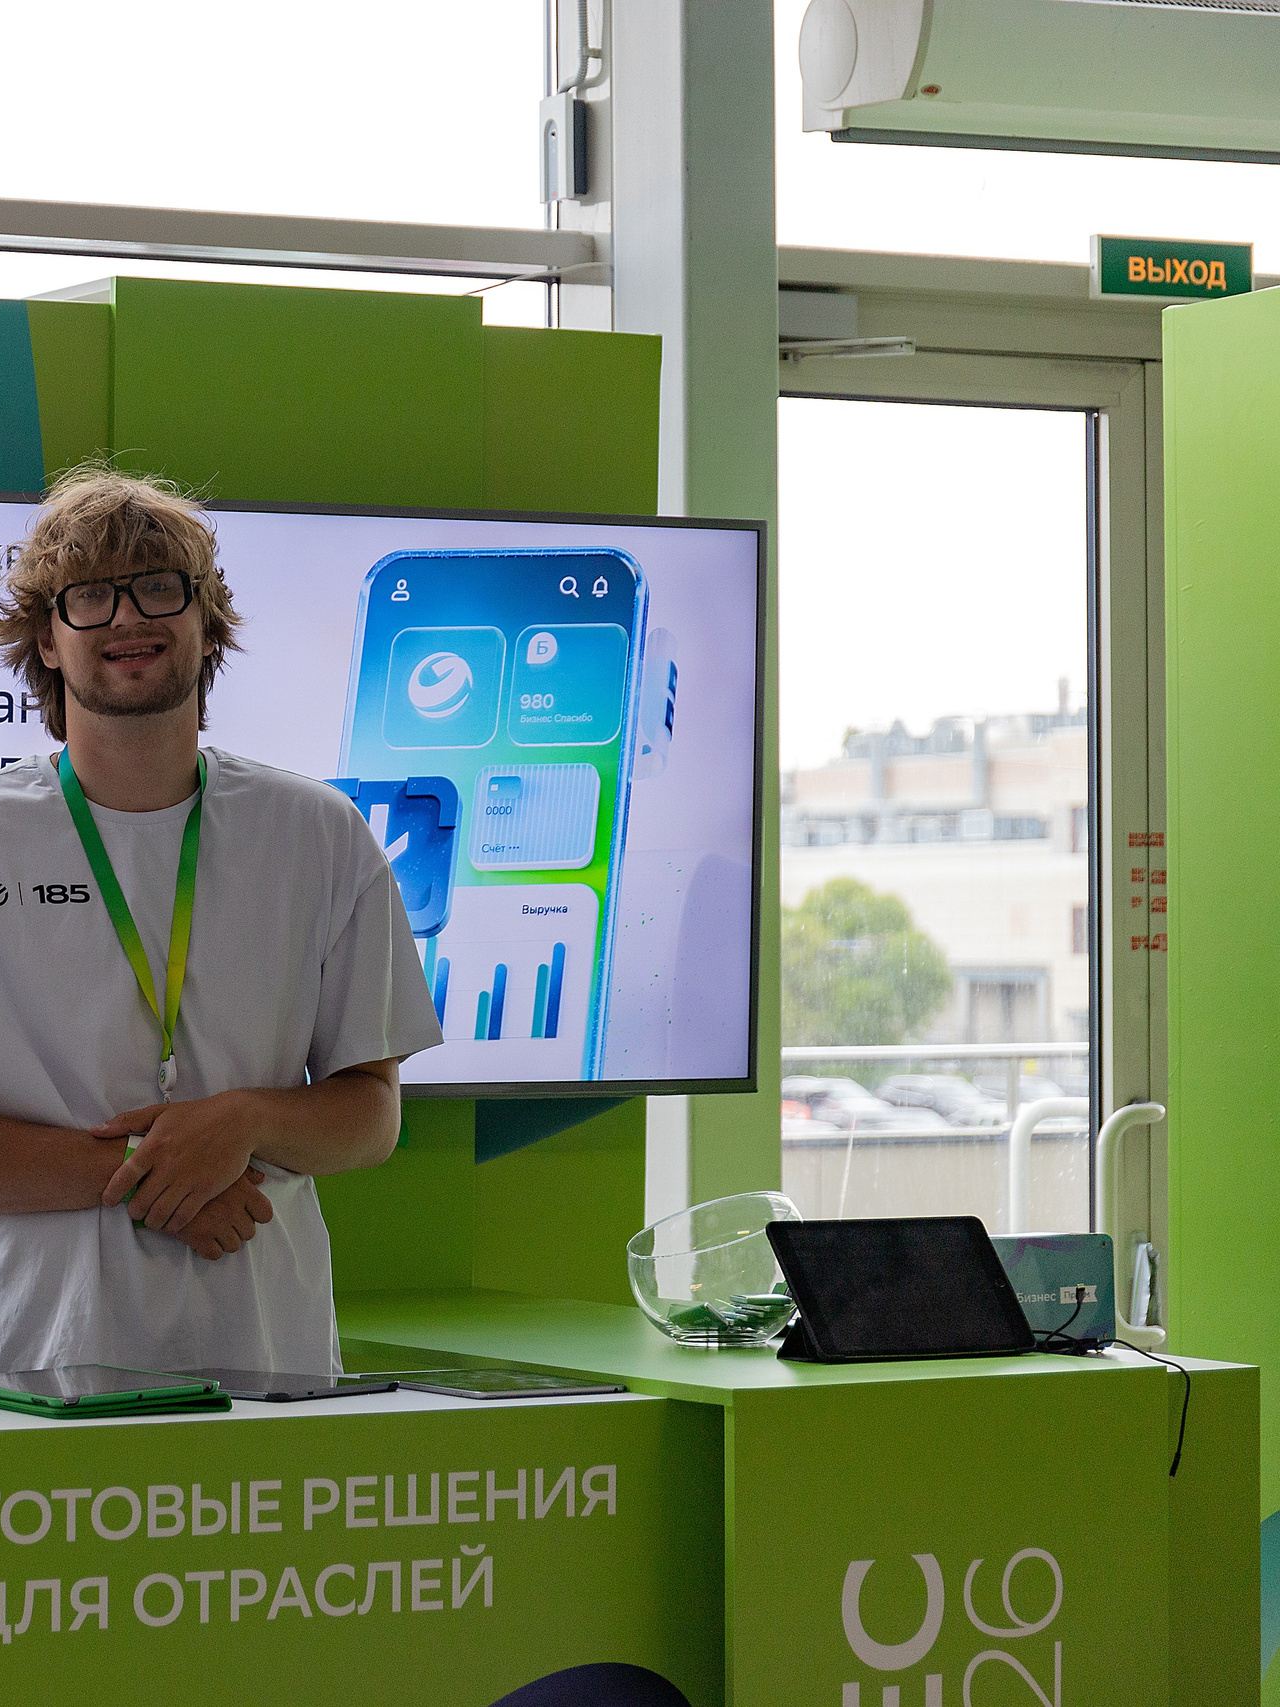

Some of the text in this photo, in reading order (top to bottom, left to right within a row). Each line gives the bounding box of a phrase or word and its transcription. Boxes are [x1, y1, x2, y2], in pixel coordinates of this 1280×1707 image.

[1128, 256, 1227, 291] ВЫХОД
[520, 693, 554, 709] 980
[520, 712, 593, 723] Бизнес Спасибо
[481, 843, 505, 853] Счёт
[32, 884, 91, 905] 185
[522, 904, 568, 916] Выручка
[303, 1464, 617, 1531] РЕШЕНИЯ
[133, 1543, 494, 1627] ОТРАСЛЕЙ
